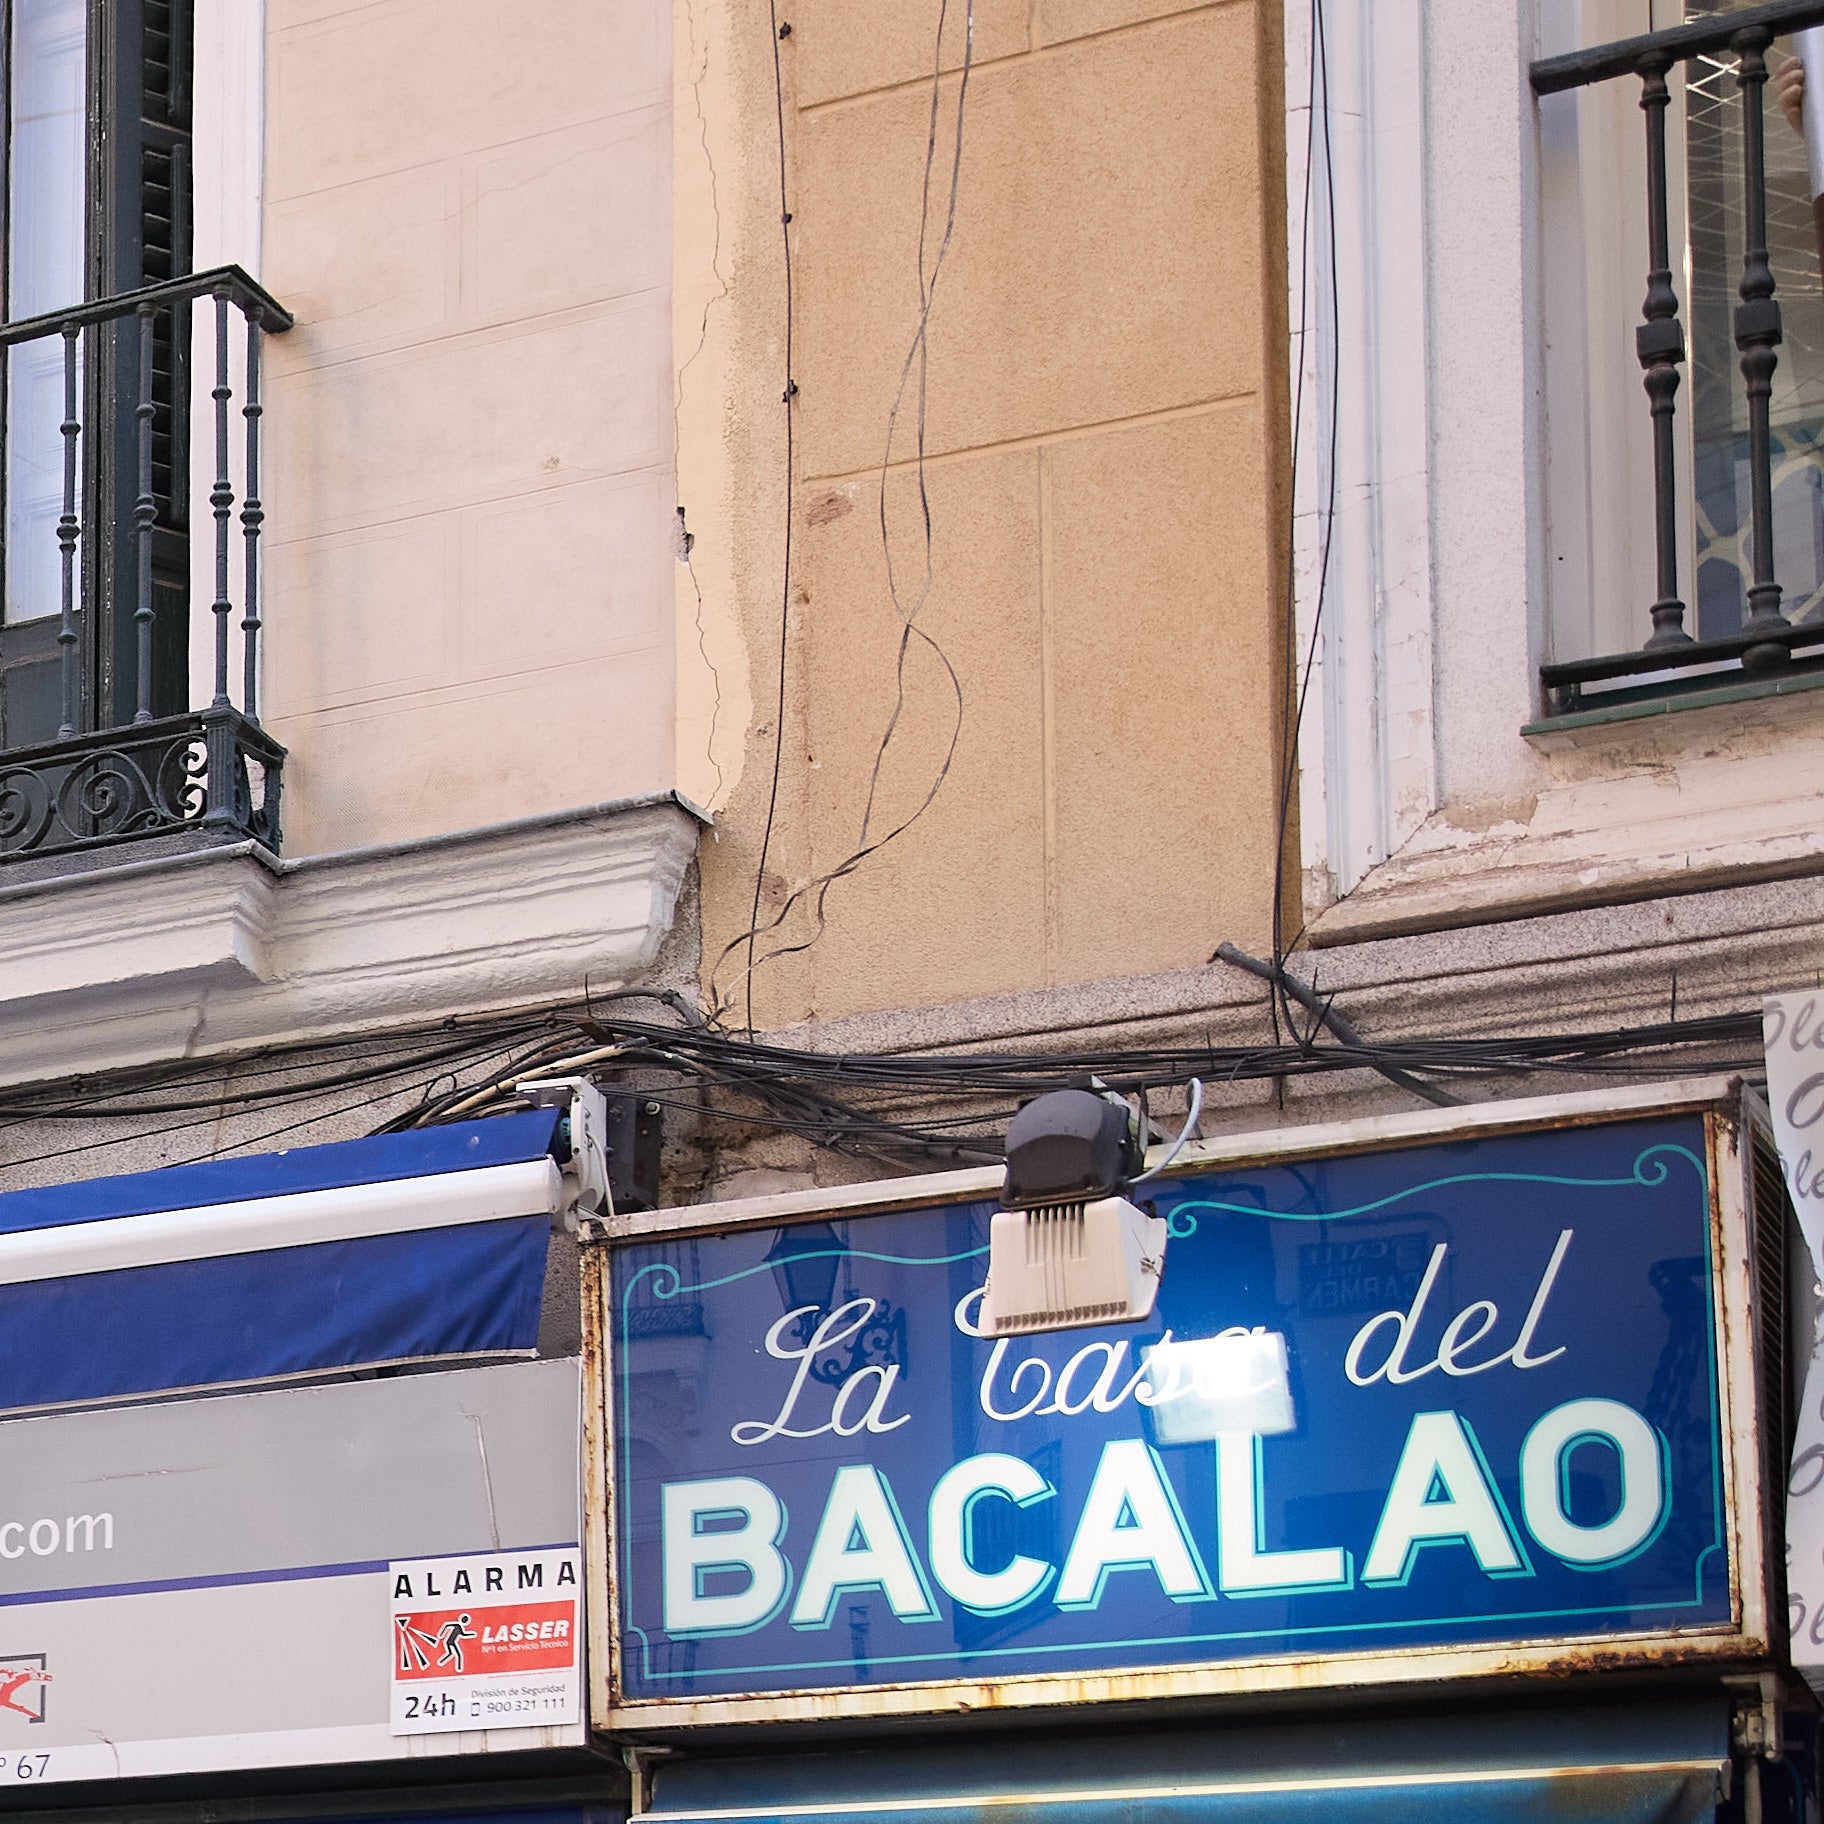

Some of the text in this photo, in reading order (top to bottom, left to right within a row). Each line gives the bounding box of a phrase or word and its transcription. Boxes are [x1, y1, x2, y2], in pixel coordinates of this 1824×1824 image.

[731, 1296, 910, 1445] La
[1347, 1228, 1574, 1388] del
[661, 1397, 1675, 1643] BACALAO
[394, 1561, 576, 1598] ALARMA
[481, 1620, 569, 1644] LASSER
[471, 1684, 565, 1699] División de Seguridad
[405, 1693, 565, 1718] 24h 900 321 111
[17, 1755, 51, 1779] 67
